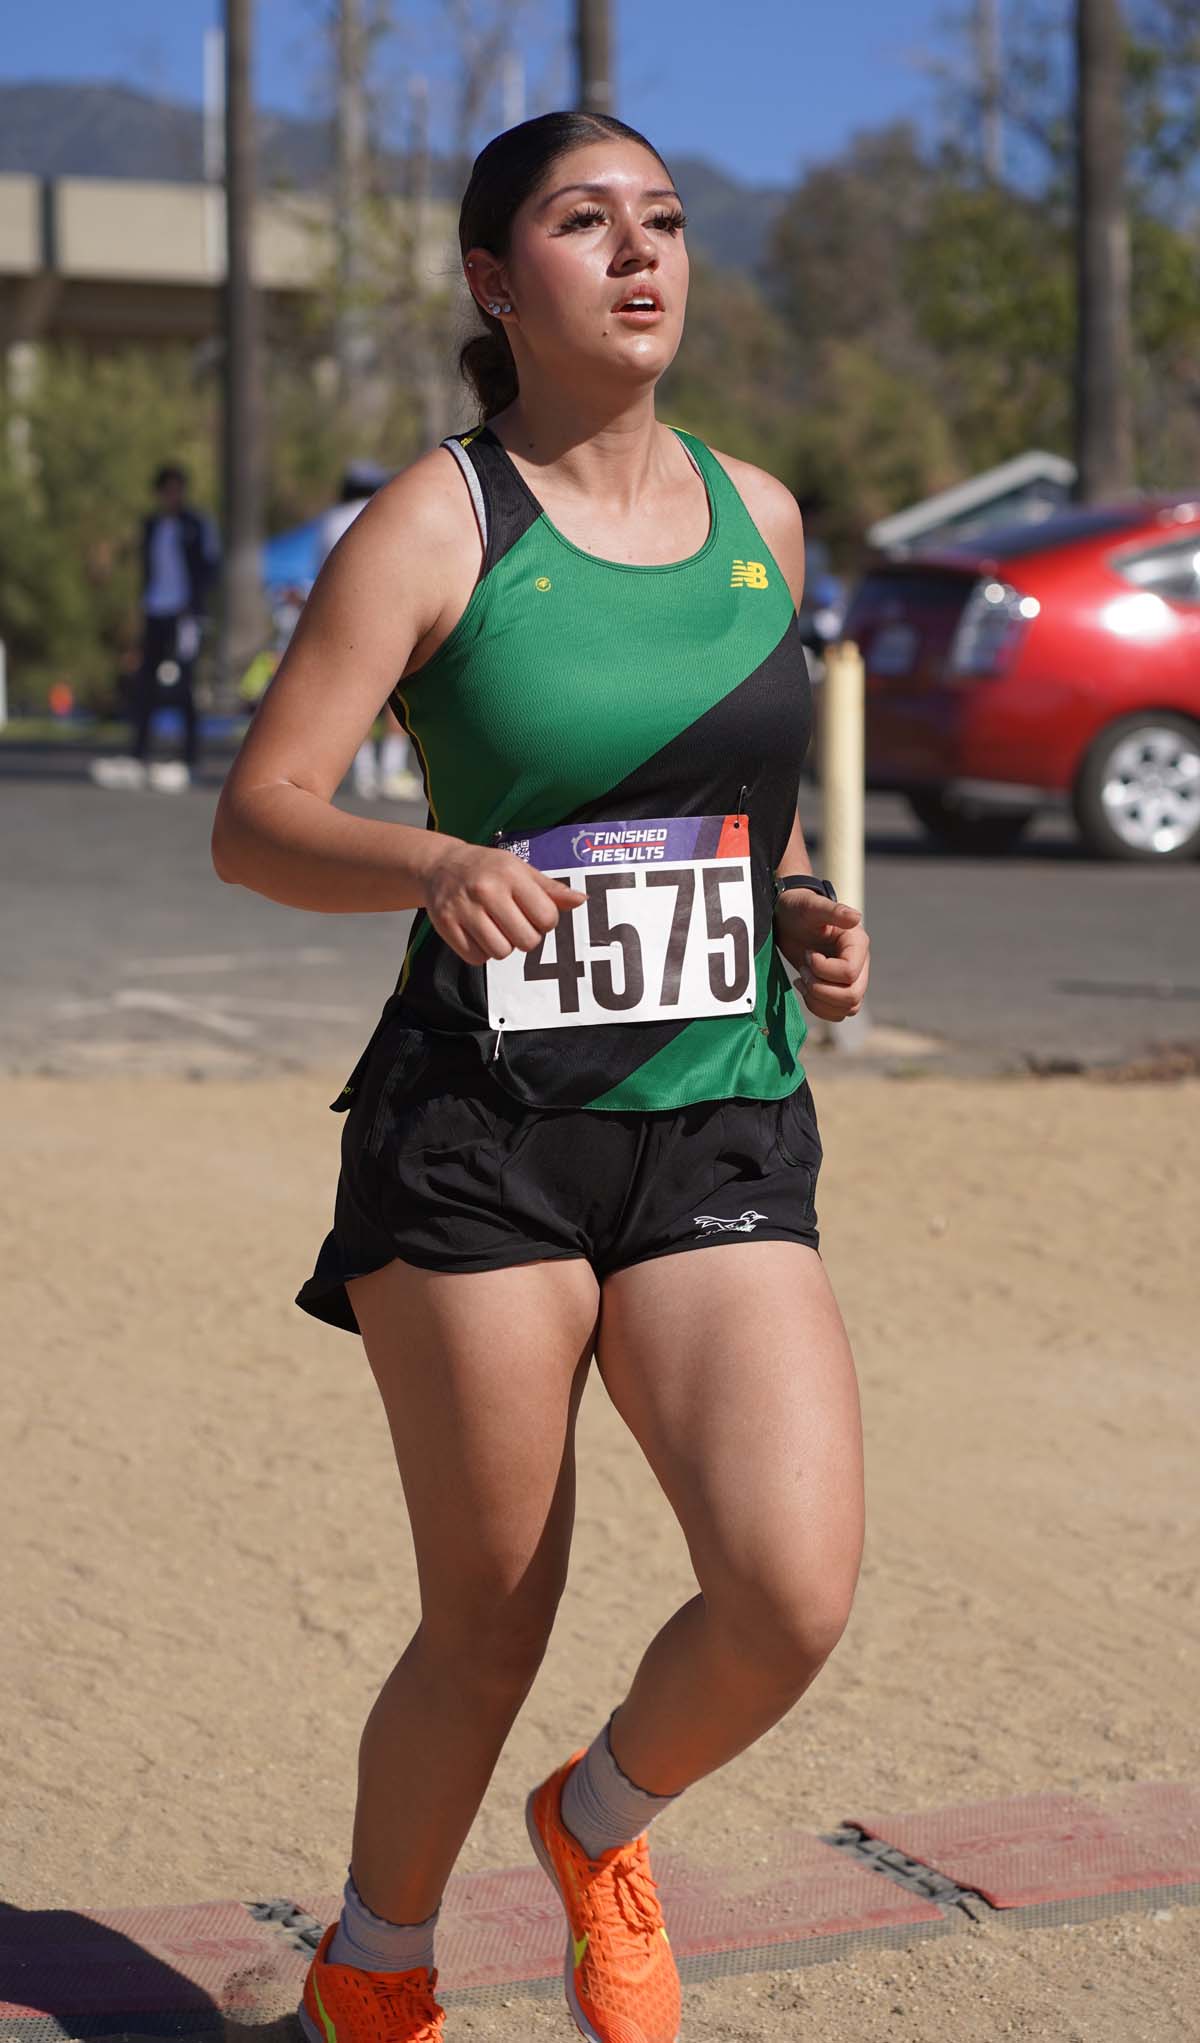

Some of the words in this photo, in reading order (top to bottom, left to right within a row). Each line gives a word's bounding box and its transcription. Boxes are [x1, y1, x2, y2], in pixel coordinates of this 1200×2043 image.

[593, 828, 668, 845] FINISHED
[591, 846, 665, 863] RESULTS
[524, 866, 750, 1013] 4575
